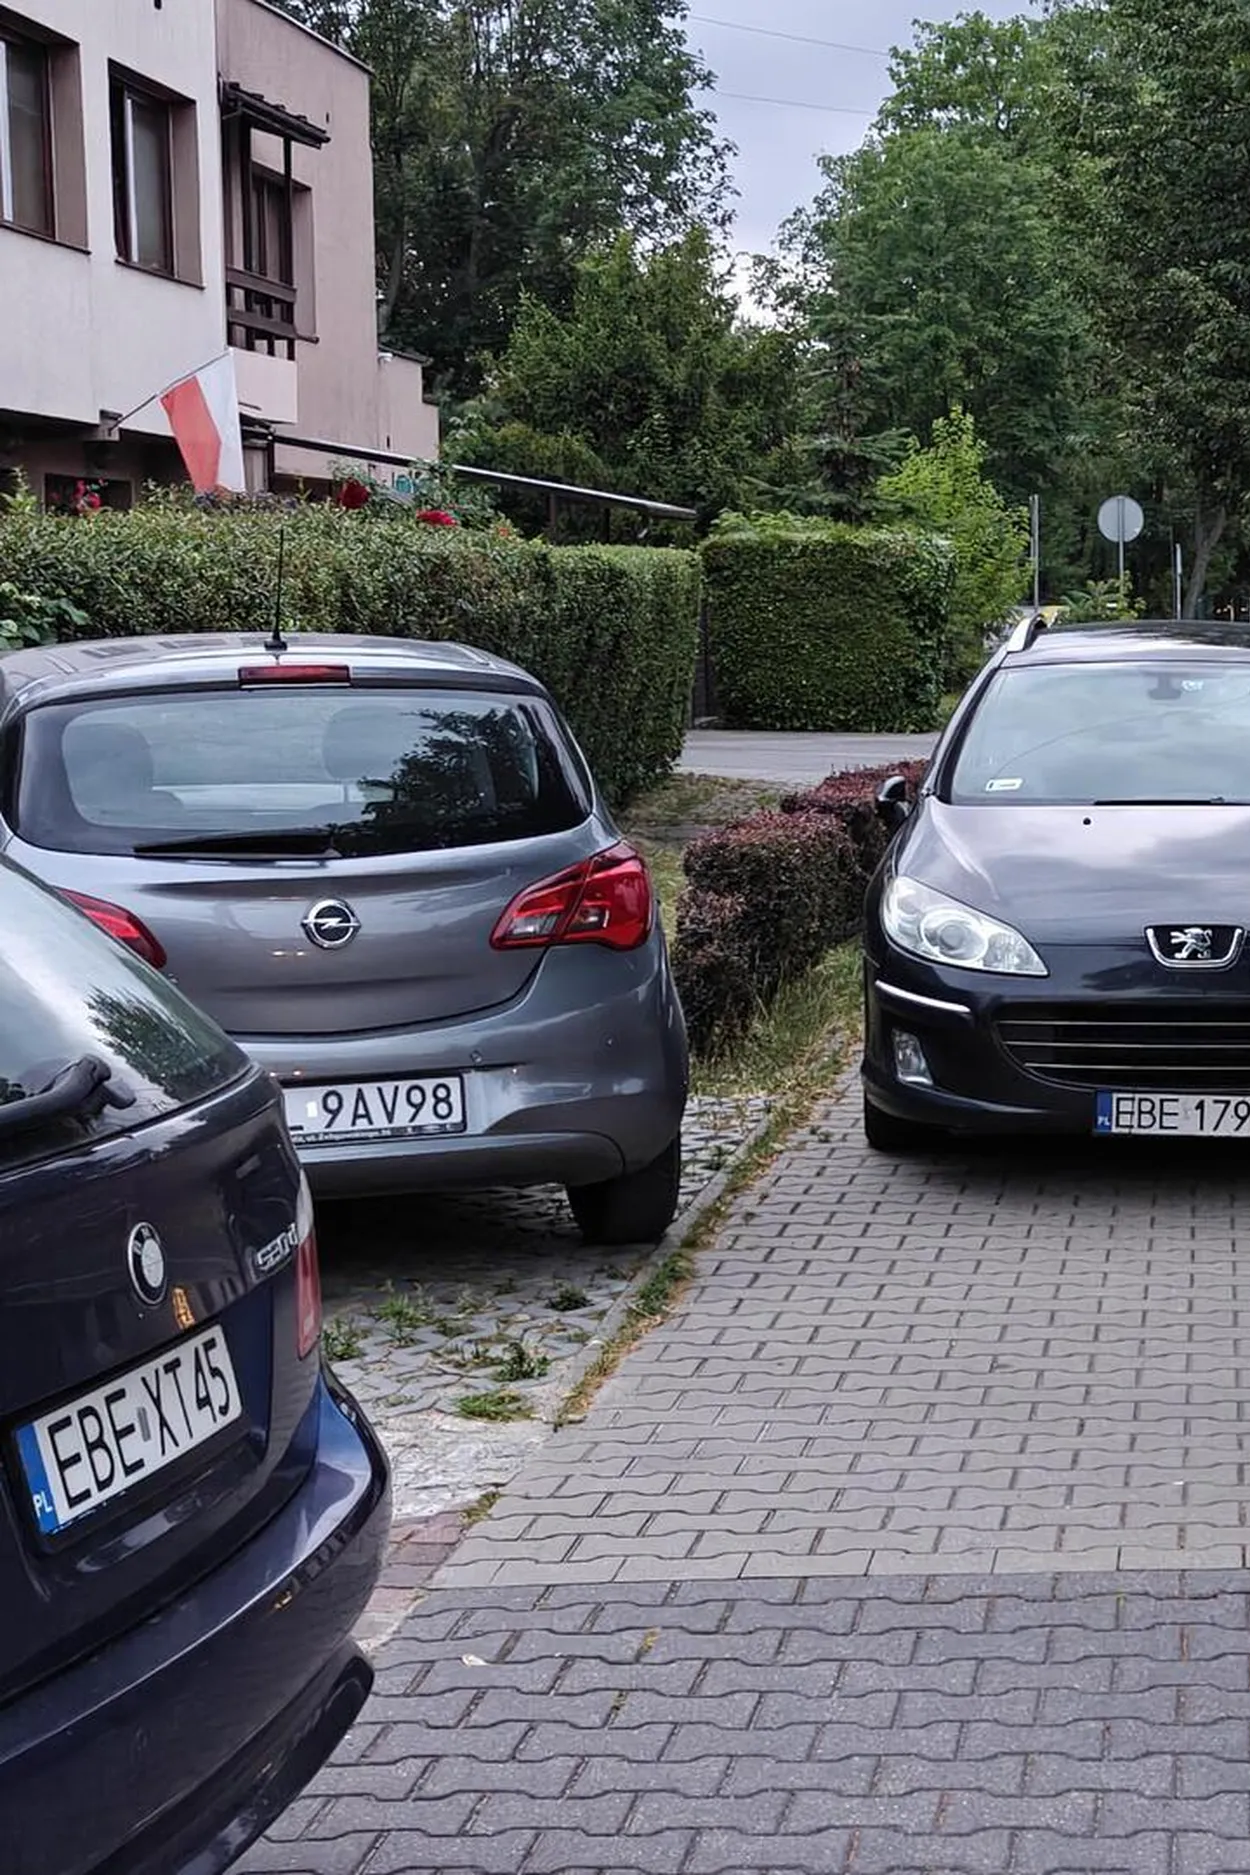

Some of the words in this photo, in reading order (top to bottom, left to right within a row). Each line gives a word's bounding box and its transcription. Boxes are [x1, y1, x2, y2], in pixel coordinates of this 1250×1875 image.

[321, 1082, 454, 1130] 9AV98
[1114, 1096, 1180, 1130] EBE
[32, 1490, 53, 1520] PL
[46, 1387, 146, 1510] EBE
[140, 1336, 231, 1457] XT45
